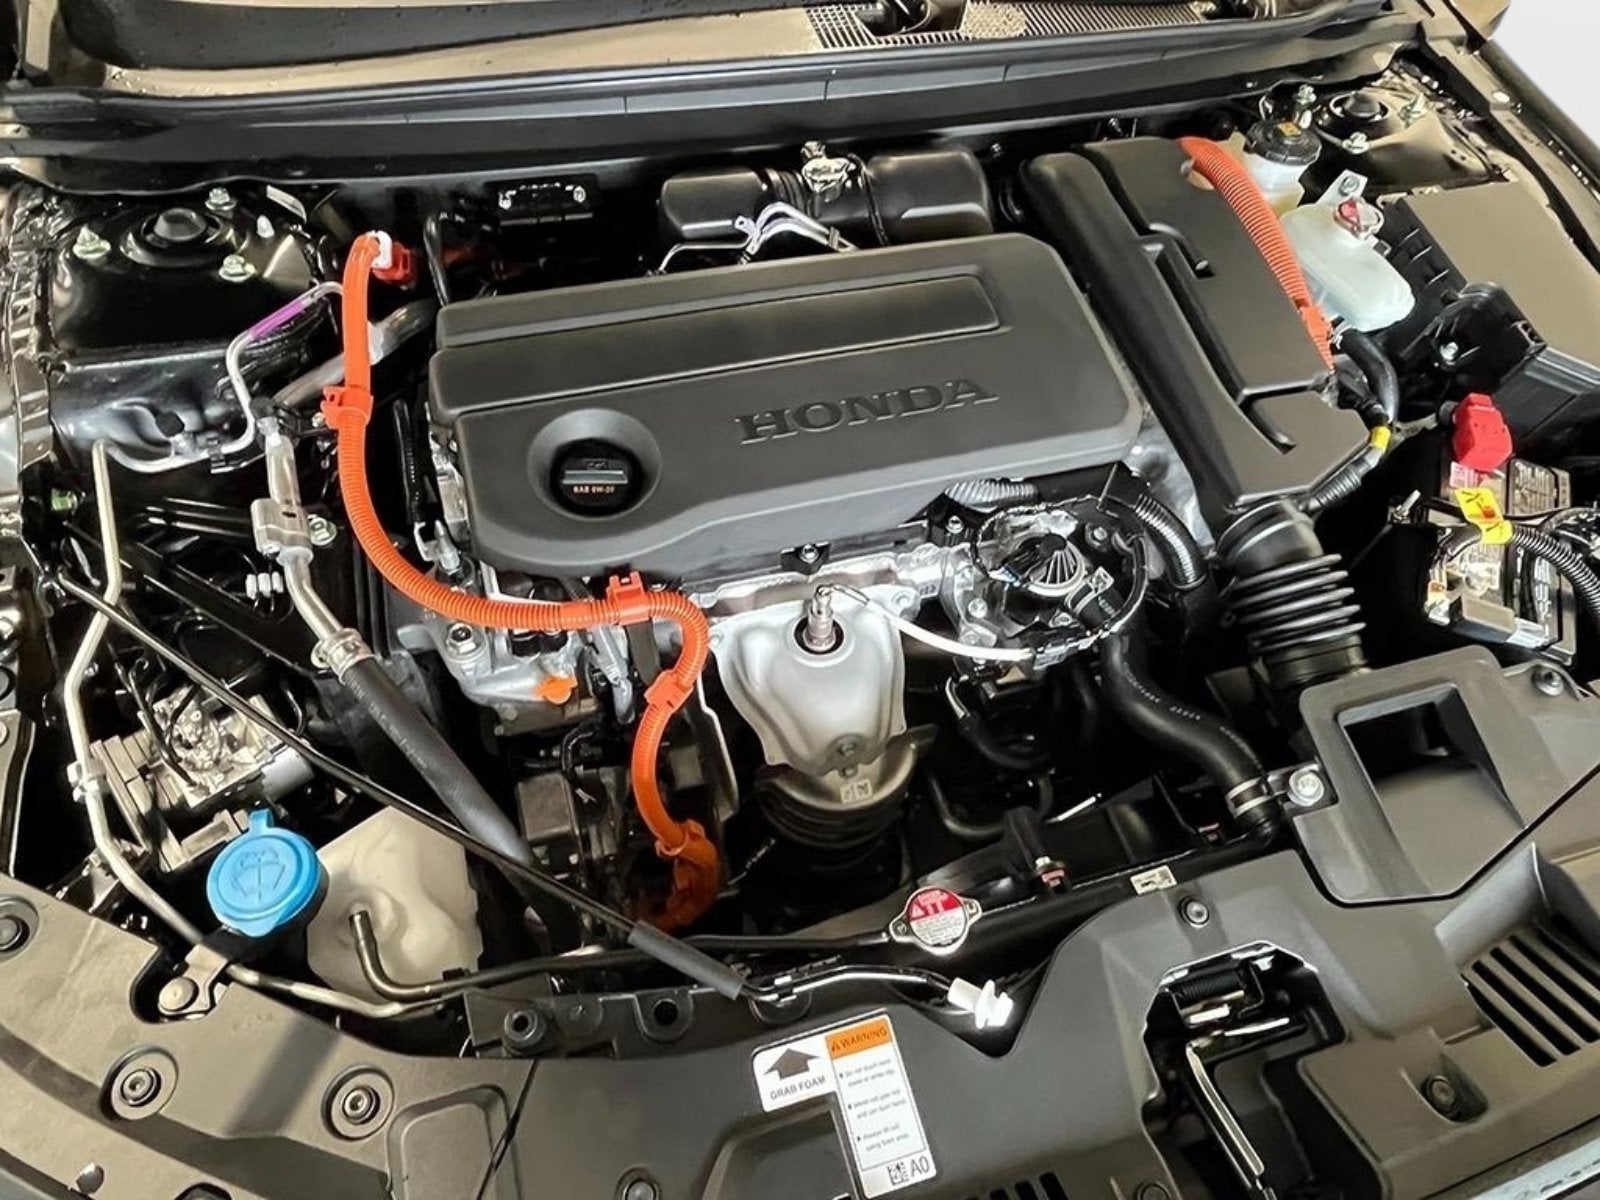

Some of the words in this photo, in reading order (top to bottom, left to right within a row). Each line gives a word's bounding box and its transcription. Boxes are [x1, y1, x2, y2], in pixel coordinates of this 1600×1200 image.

[734, 379, 999, 444] HONDA
[840, 1028, 887, 1048] WARNING
[799, 1075, 826, 1091] FOAM
